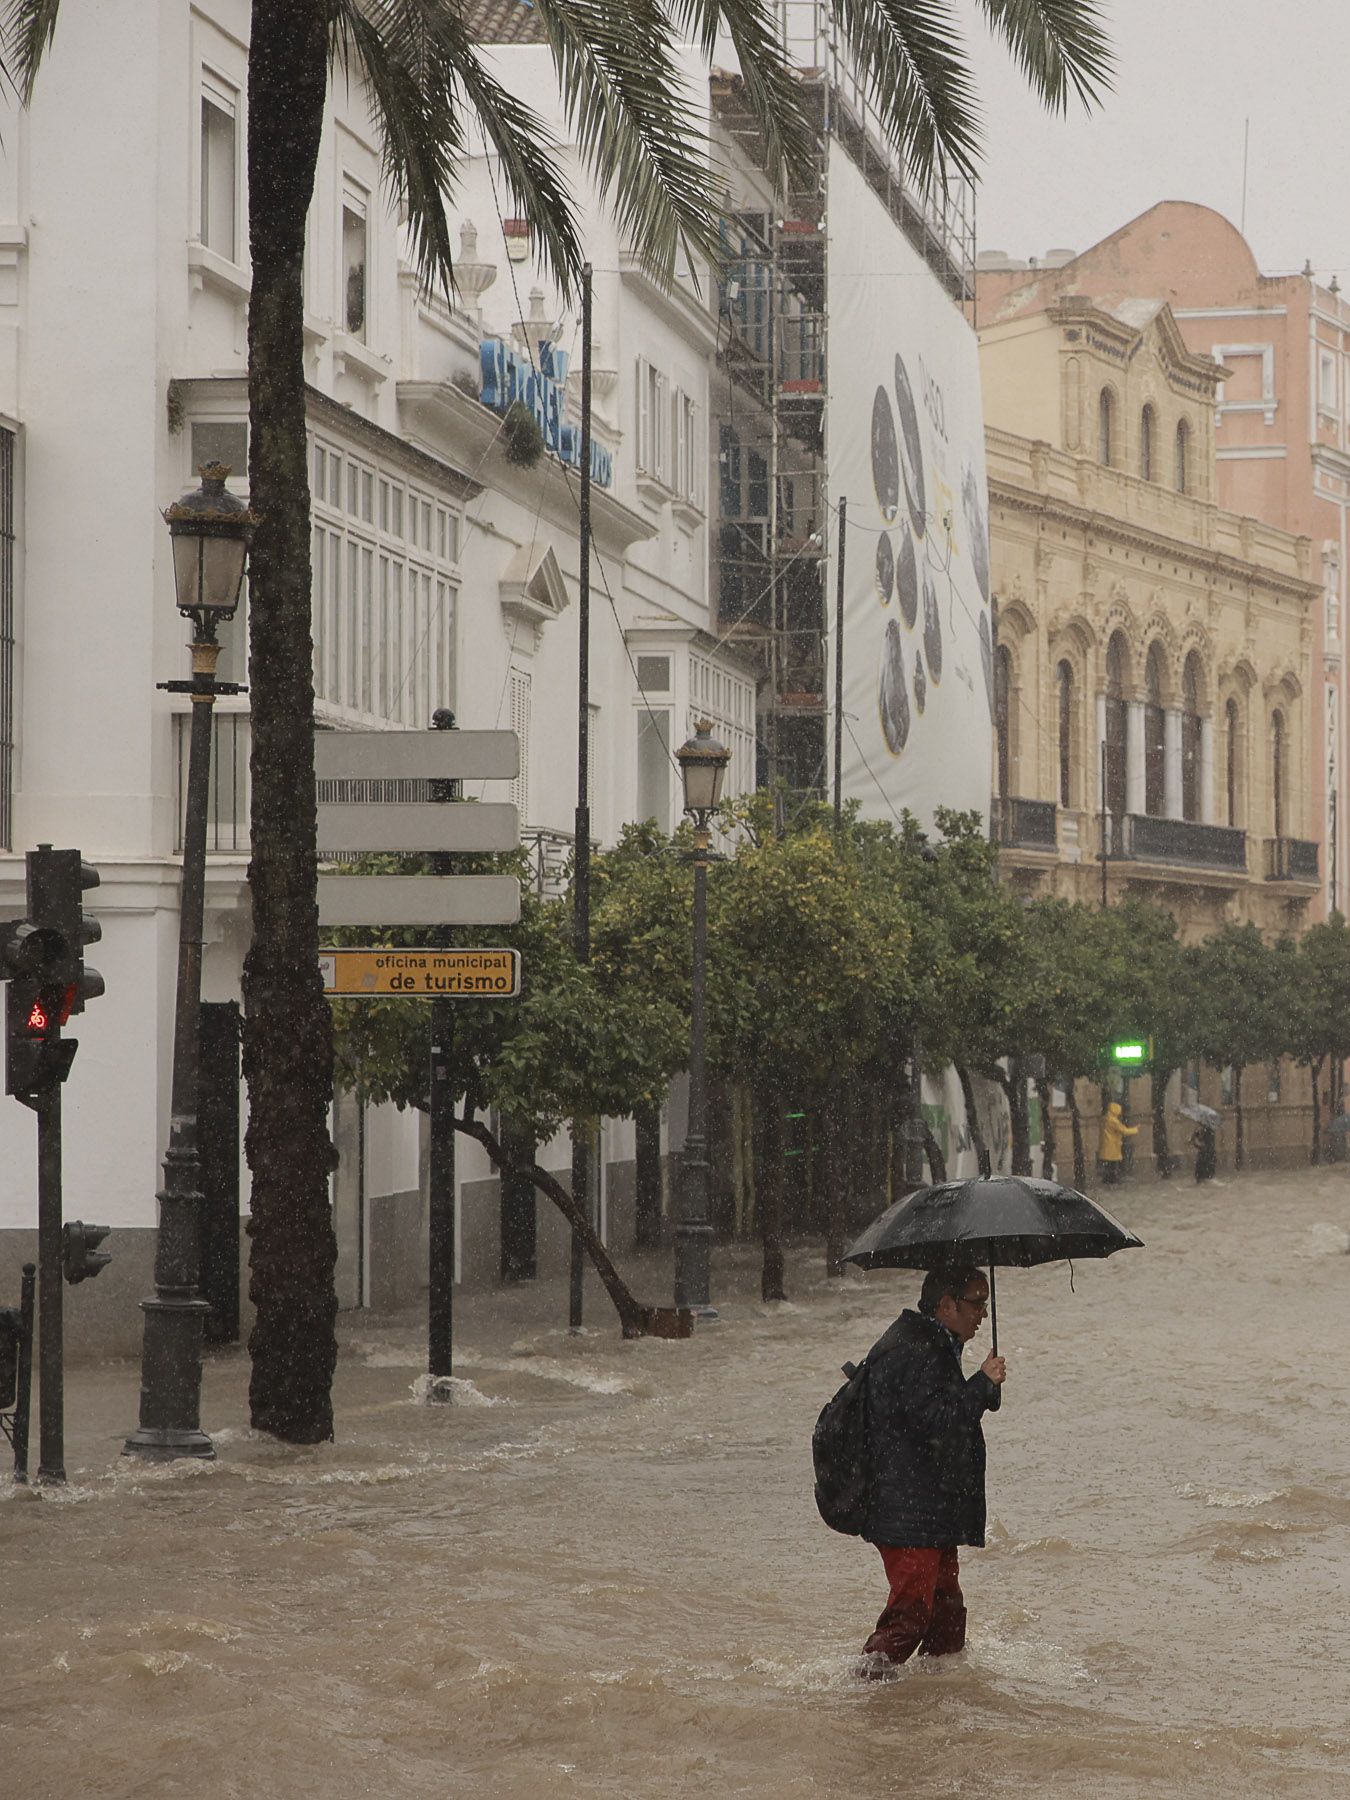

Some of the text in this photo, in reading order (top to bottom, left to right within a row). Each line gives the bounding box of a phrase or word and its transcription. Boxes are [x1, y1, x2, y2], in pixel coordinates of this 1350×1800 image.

[376, 956, 507, 970] oficina municipal
[390, 973, 507, 989] de turismo
